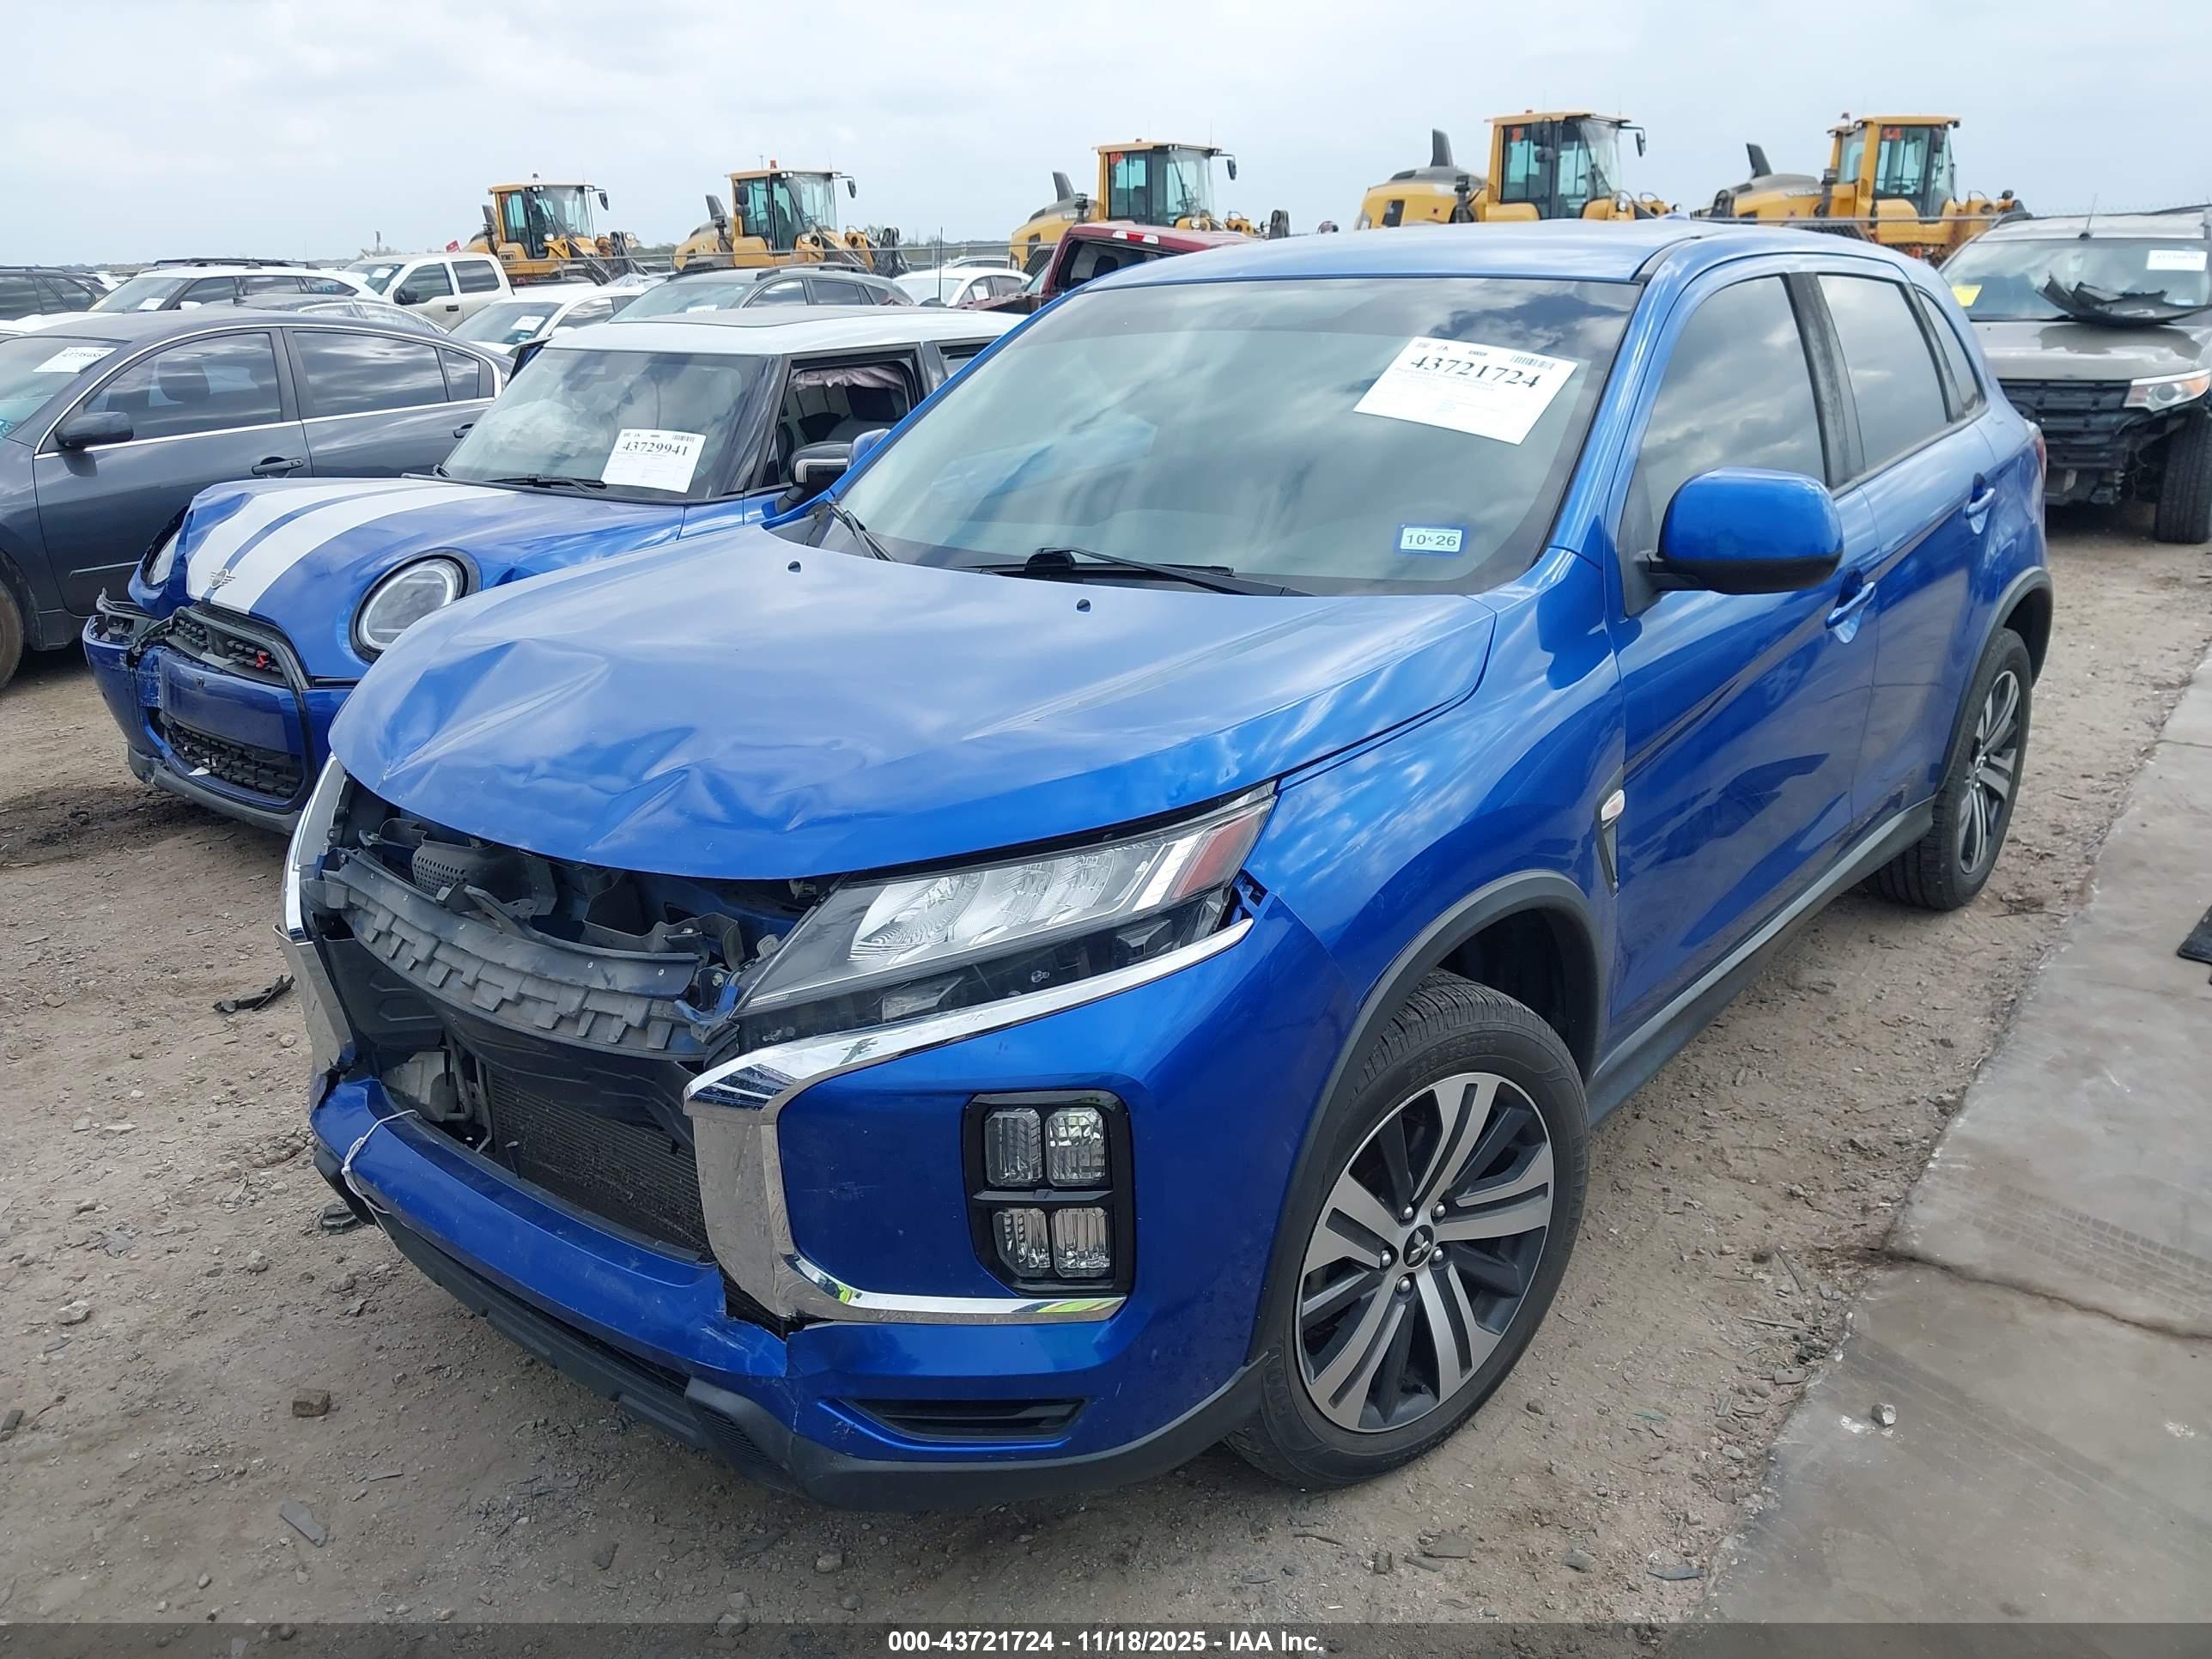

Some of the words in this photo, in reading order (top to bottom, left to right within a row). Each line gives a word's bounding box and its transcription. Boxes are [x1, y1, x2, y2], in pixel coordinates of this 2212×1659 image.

[1411, 356, 1540, 387] 43721724
[622, 441, 689, 456] 43729941
[1407, 534, 1426, 545] 10
[1436, 535, 1457, 546] 26
